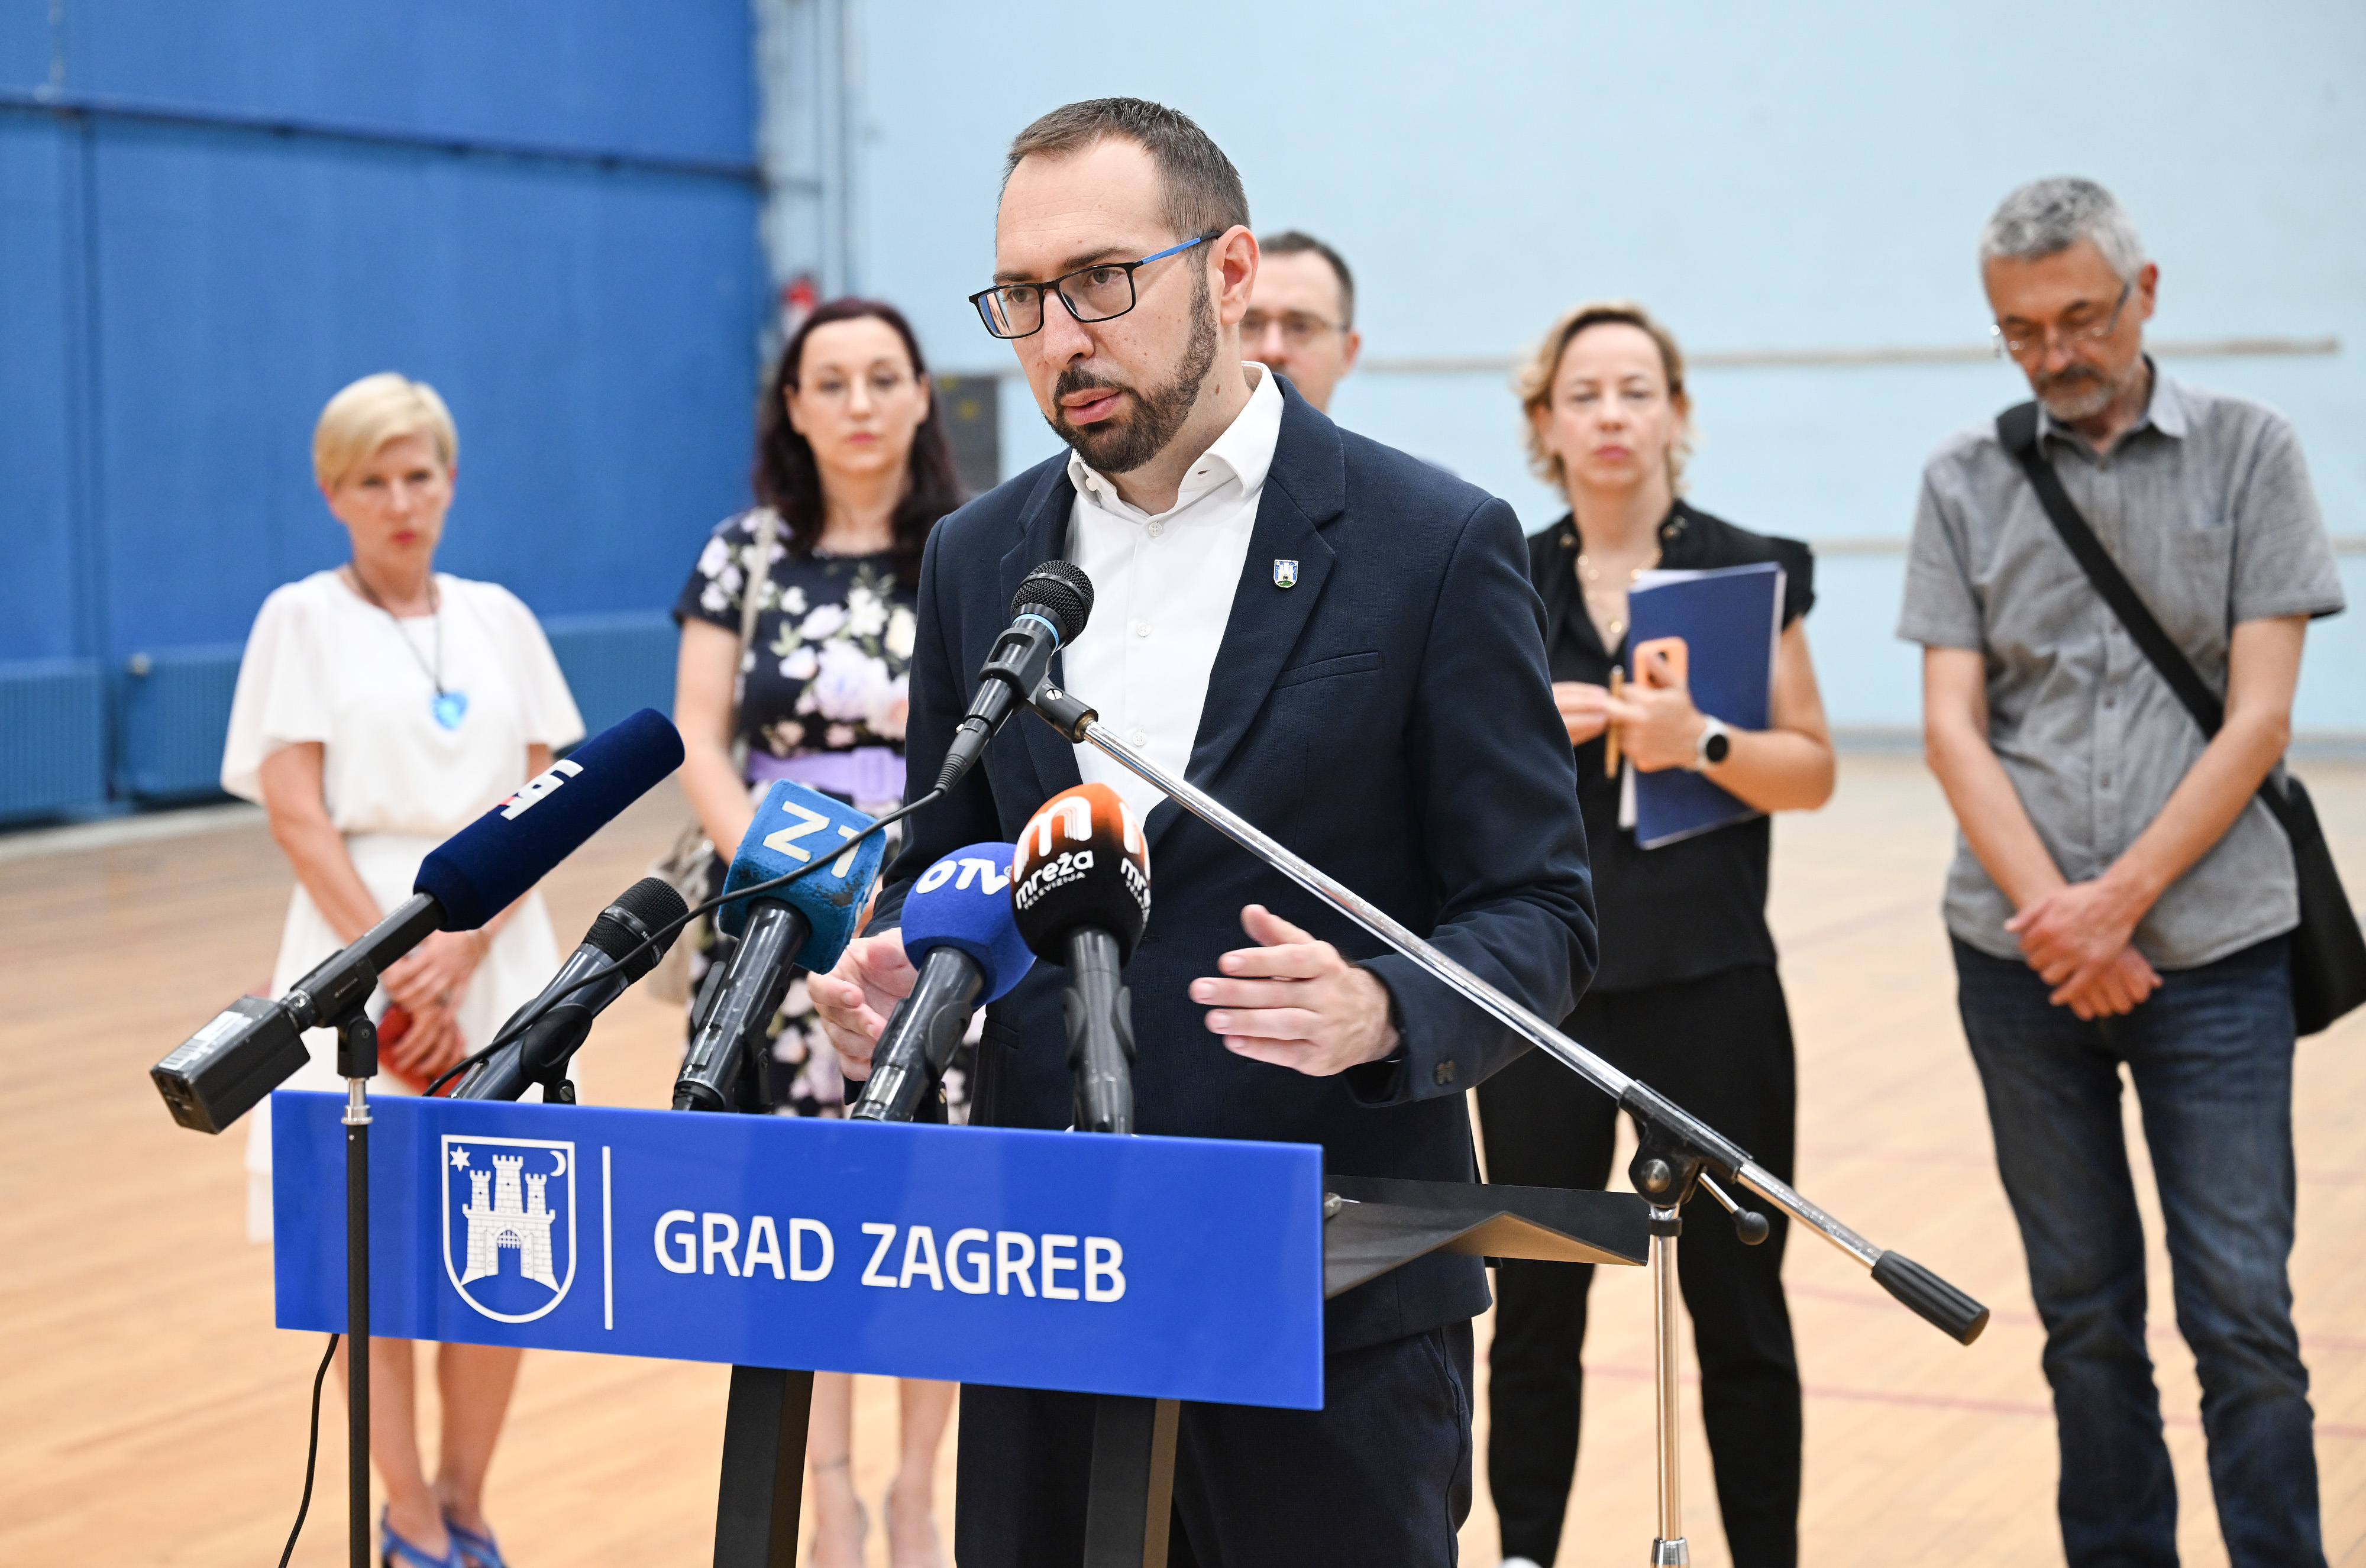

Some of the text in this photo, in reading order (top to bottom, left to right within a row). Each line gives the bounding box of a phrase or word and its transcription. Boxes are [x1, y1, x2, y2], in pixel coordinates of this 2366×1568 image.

[916, 858, 1011, 895] OTV
[1015, 850, 1094, 910] mreža
[654, 1209, 1127, 1303] GRAD ZAGREB
